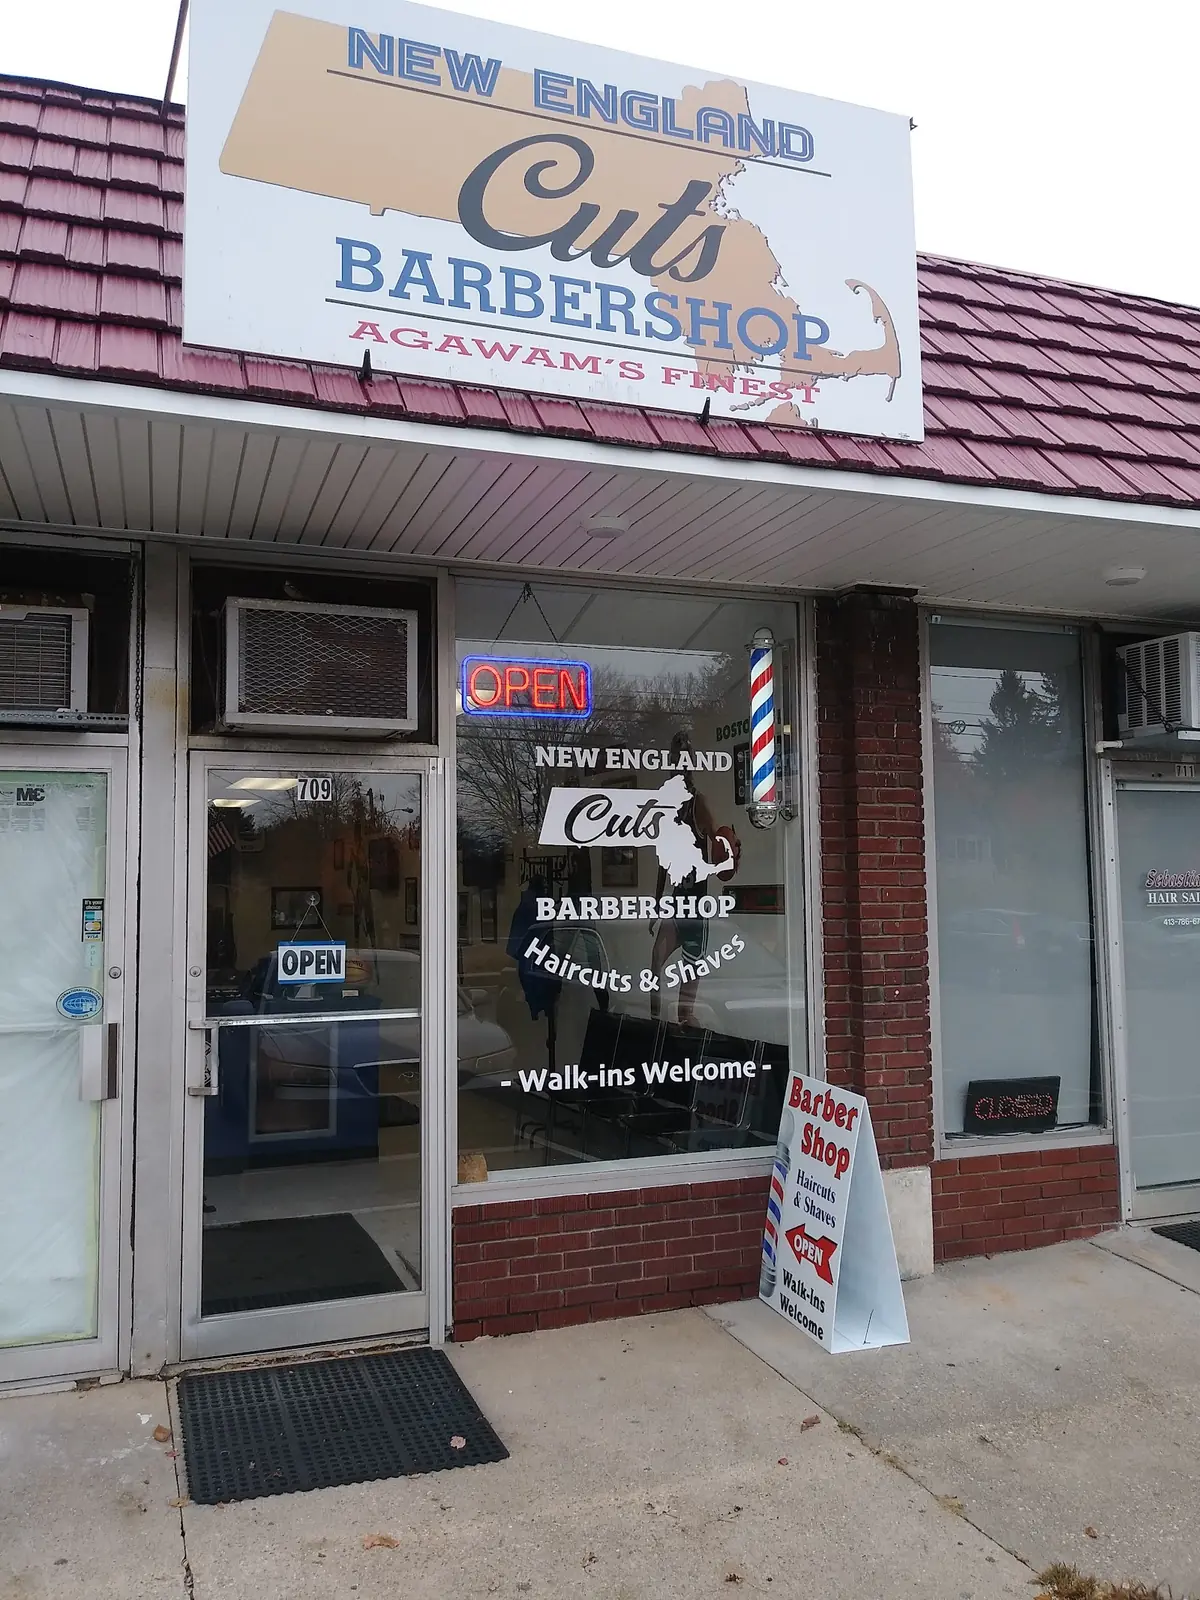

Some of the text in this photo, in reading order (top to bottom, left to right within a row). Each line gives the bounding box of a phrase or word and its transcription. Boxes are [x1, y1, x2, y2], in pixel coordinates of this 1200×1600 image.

[348, 26, 815, 163] NEW ENGLAND
[458, 133, 727, 283] Cuts
[335, 236, 830, 361] BARBERSHOP
[349, 320, 821, 404] AGAWAM'S FINEST
[470, 665, 586, 710] OPEN
[716, 718, 750, 742] BOSTO
[535, 746, 733, 772] NEW ENGLAND
[1176, 764, 1194, 777] 711
[299, 778, 331, 800] 709
[564, 793, 676, 844] Cuts
[536, 895, 737, 922] BARBERSHOP
[1148, 892, 1200, 904] HAIR SAL
[282, 950, 342, 976] OPEN
[523, 933, 746, 993] Haircuts & Shaves
[518, 1060, 636, 1093] Walk-ins
[641, 1058, 756, 1085] Welcome
[788, 1076, 858, 1132] Barber
[801, 1122, 850, 1180] Shop
[796, 1168, 837, 1204] Haircuts
[793, 1191, 837, 1229] & Shaves
[793, 1233, 824, 1267] OPEN
[782, 1267, 826, 1314] Walk-Ins
[779, 1292, 825, 1341] Welcome
